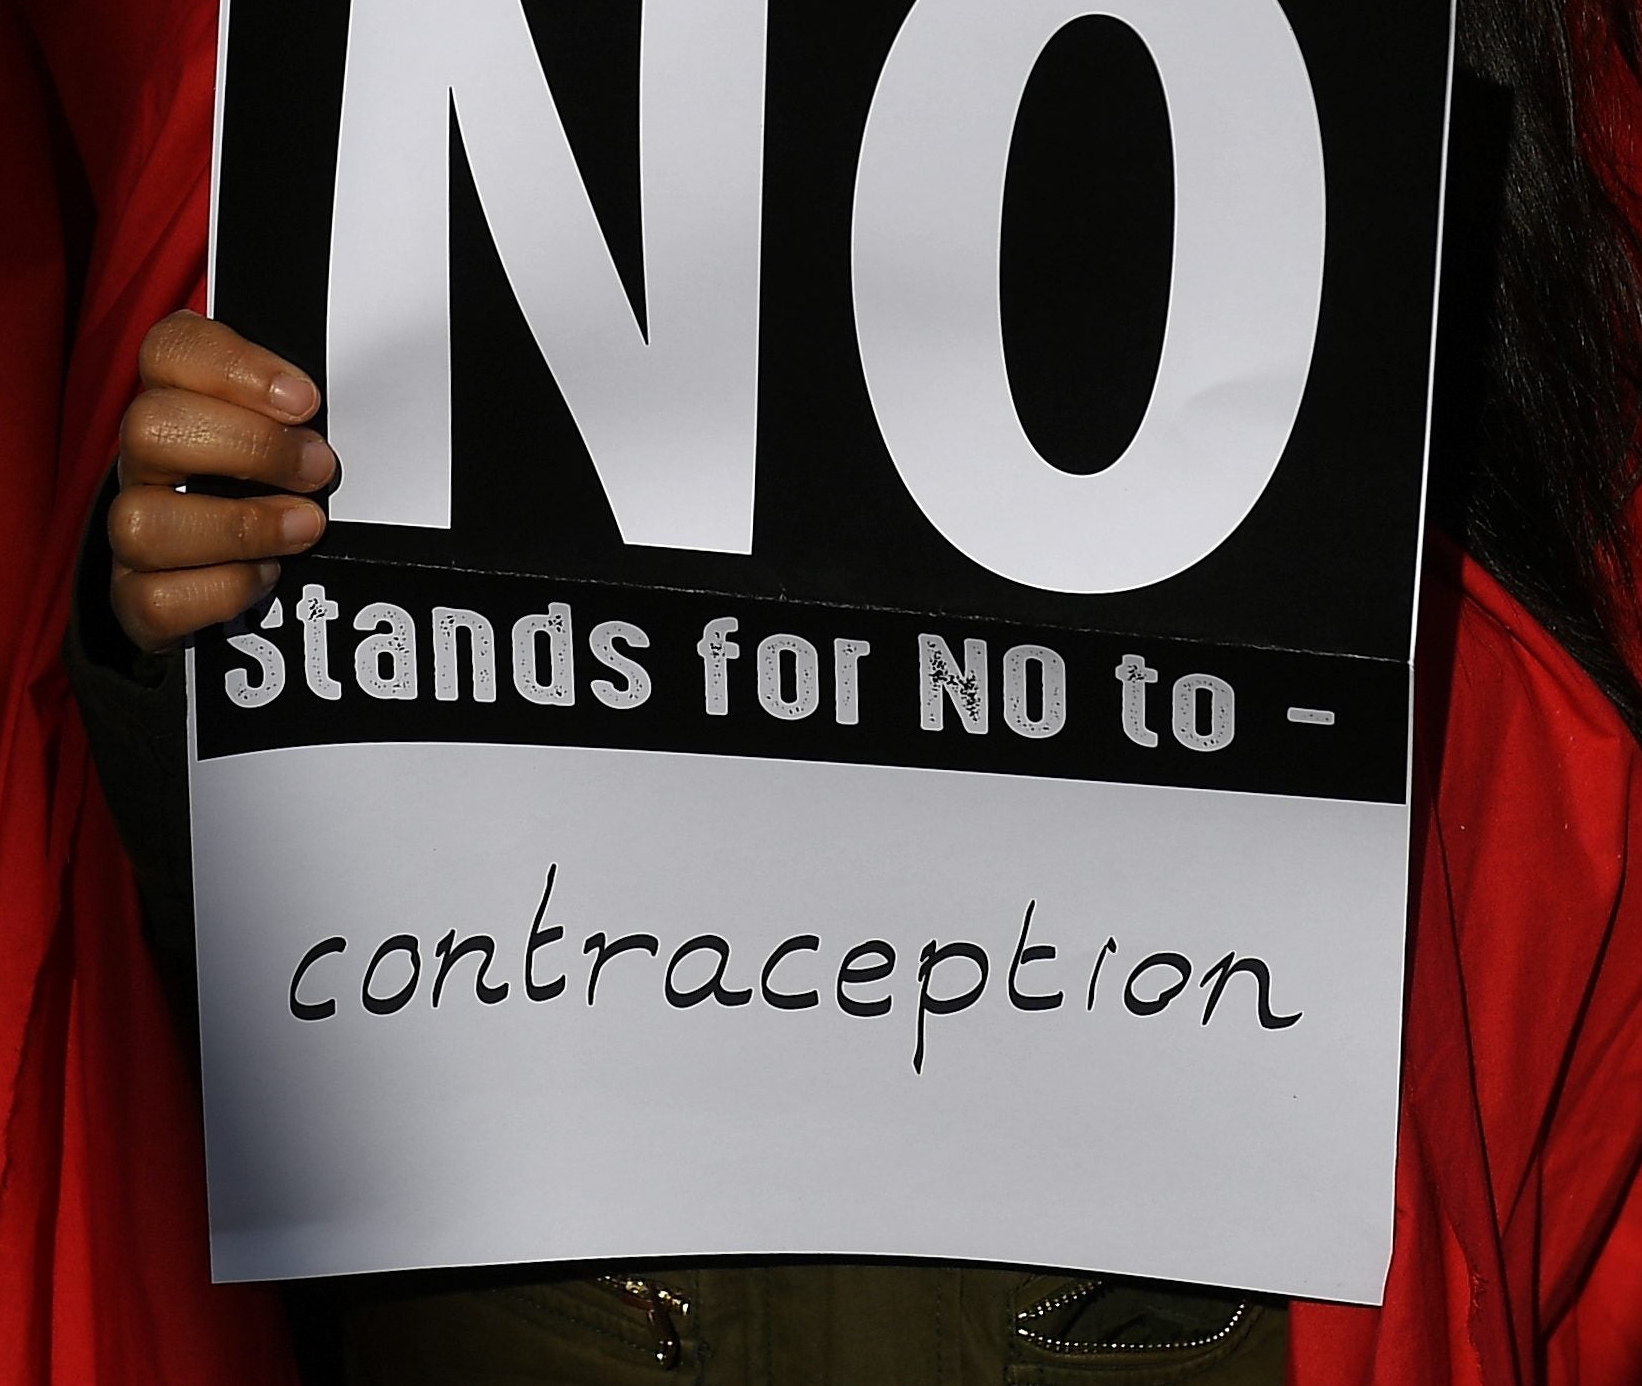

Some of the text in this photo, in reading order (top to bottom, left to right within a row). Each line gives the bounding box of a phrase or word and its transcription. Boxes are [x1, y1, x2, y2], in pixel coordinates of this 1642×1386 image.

[224, 584, 652, 708] Stands
[698, 617, 870, 725] for
[918, 633, 1067, 737] NO
[1115, 653, 1236, 752] to
[289, 863, 1302, 1074] contraception
